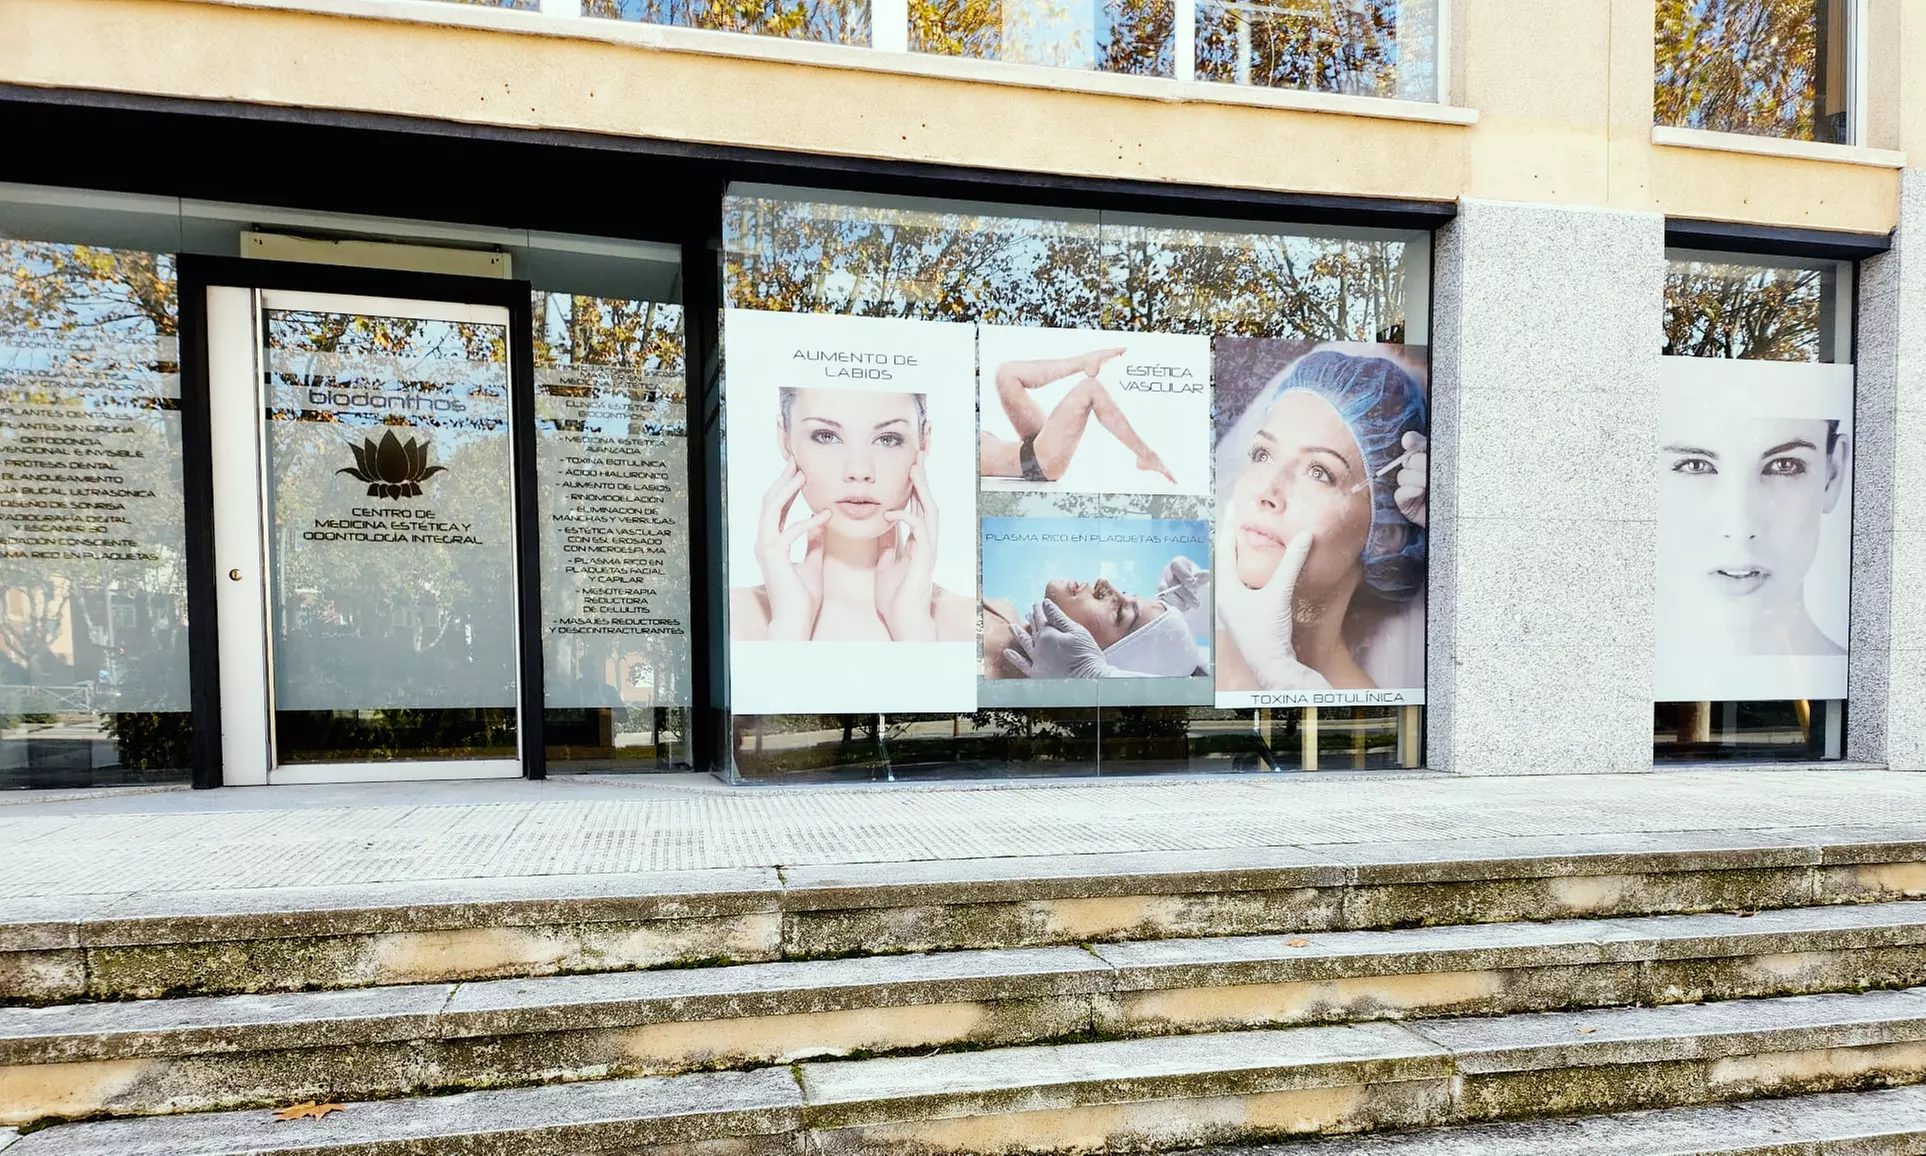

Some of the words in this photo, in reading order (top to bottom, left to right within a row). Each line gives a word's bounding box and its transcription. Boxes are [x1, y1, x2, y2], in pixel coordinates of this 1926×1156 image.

[792, 349, 888, 365] AUMENTO
[893, 354, 918, 366] DE
[824, 366, 893, 380] LABIOS
[1126, 362, 1194, 378] ESTÉTICA
[1119, 380, 1204, 394] VASCULAR
[565, 436, 615, 445] MEDICINA
[69, 462, 119, 470] DENTAL
[566, 456, 604, 466] TOXINA
[21, 486, 67, 495] BUCAL
[562, 481, 616, 490] AUMENTO
[617, 482, 632, 490] DE
[70, 502, 126, 511] SONRISA
[352, 507, 412, 519] CENTRO
[414, 509, 436, 520] DE
[644, 508, 659, 516] DE
[553, 515, 608, 523] MANCHAS
[618, 516, 676, 525] VERRUGAS
[11, 523, 22, 531] Y
[315, 519, 386, 530] MEDICINA
[390, 520, 458, 533] ESTÉTICA
[459, 523, 472, 533] Y
[615, 527, 672, 537] VASCULAR
[303, 531, 407, 543] ODONTOLOGÍA
[411, 534, 484, 545] INTEGRAL
[567, 536, 591, 544] CON
[985, 533, 1039, 542] PLASMA
[1041, 534, 1068, 542] RICO
[1071, 534, 1088, 542] EN
[1090, 535, 1162, 543] PLAQUETAS
[1163, 536, 1203, 544] FACIAL
[563, 545, 587, 553] CON
[588, 546, 667, 555] MICROESPUMA
[31, 551, 60, 560] RICO
[63, 551, 81, 560] EN
[574, 557, 621, 566] PLASMA
[623, 558, 648, 566] RICO
[648, 559, 664, 567] EN
[565, 566, 629, 575] PLAQUETAS
[629, 568, 666, 576] FACIAL
[598, 576, 644, 584] CAPILAR
[584, 596, 649, 605] REDUCTORA
[600, 606, 651, 614] CELULITIS
[559, 617, 609, 626] MASAJES
[611, 618, 681, 626] REDUCTORES
[558, 626, 685, 635] DESCONTRACTURANTES
[1251, 693, 1309, 705] TOXINA
[1313, 690, 1405, 704] BOTULÍNICA
